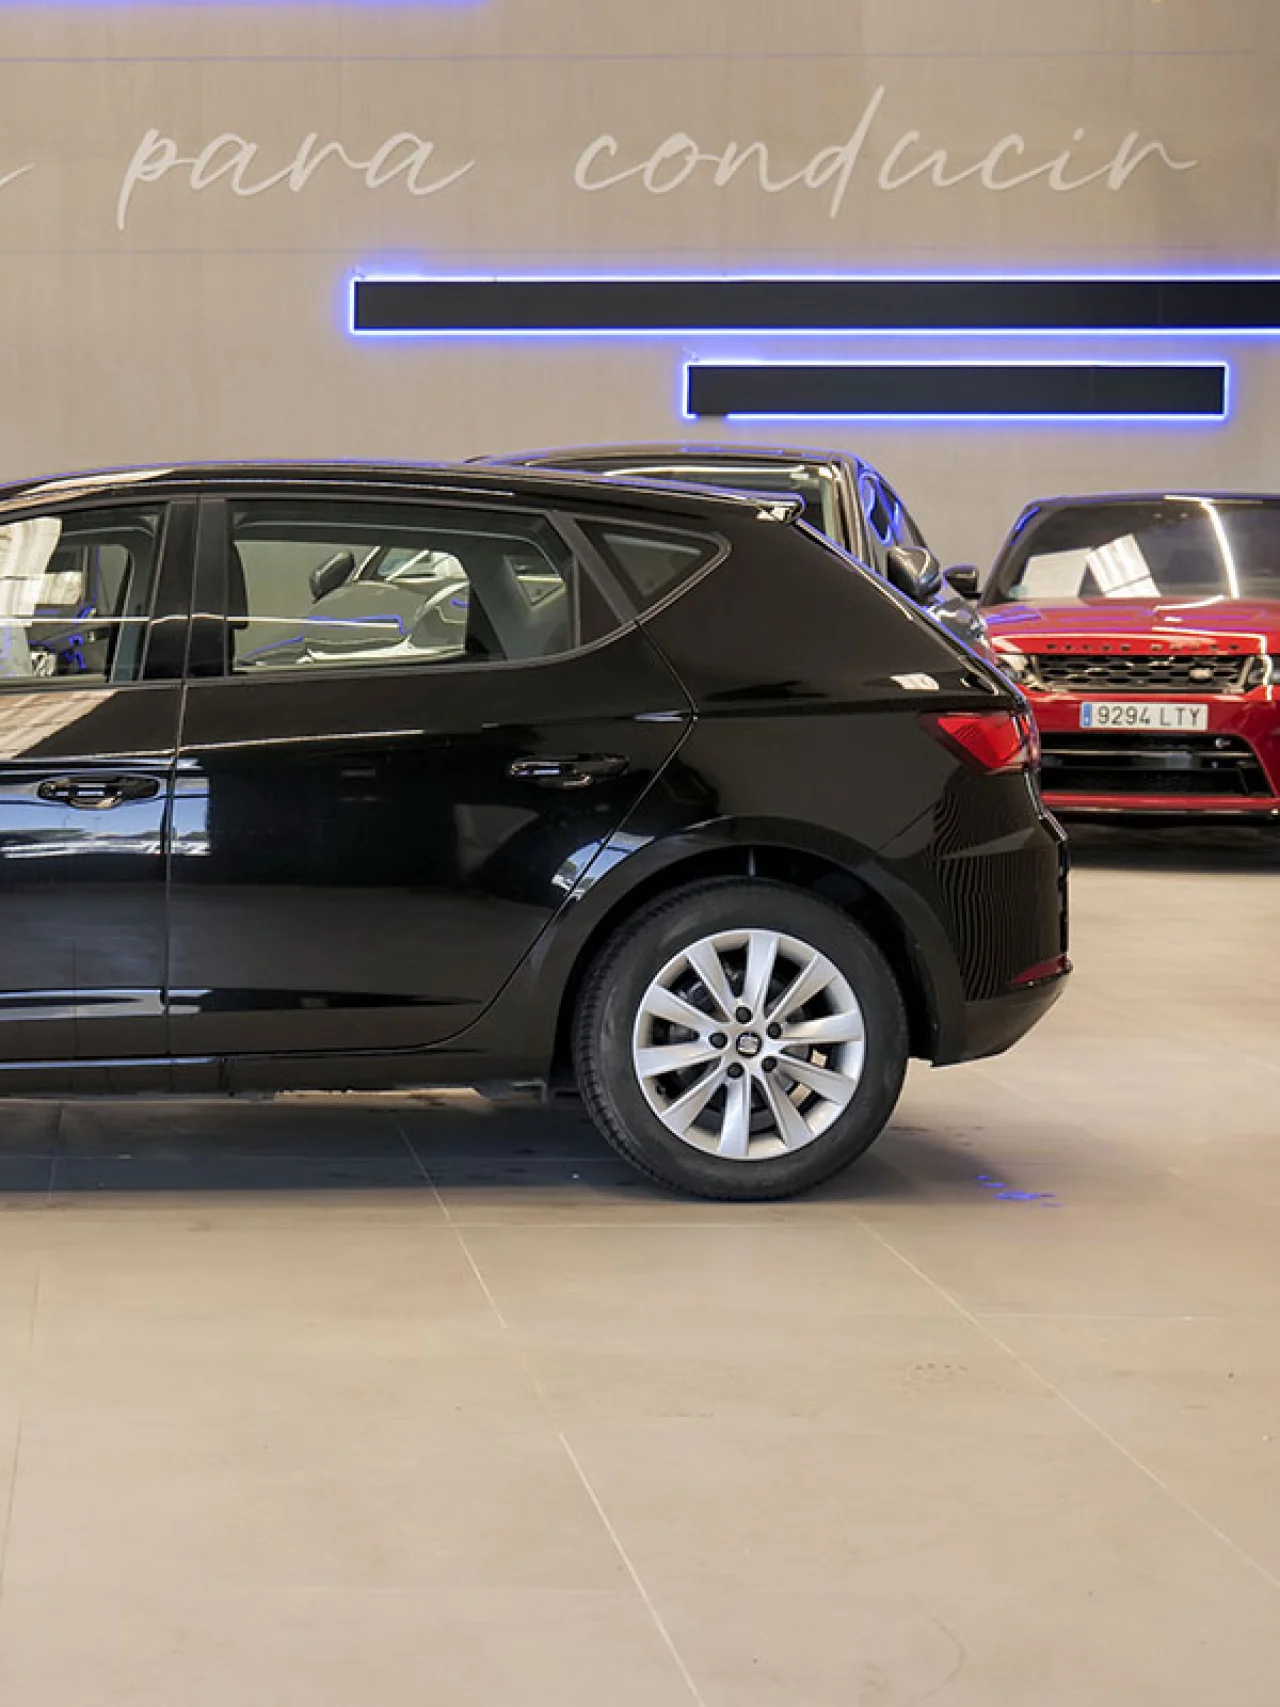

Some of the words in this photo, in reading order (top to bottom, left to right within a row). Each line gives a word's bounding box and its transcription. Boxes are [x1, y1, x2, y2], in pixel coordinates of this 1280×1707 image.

[116, 128, 476, 231] para
[573, 85, 1198, 218] conducir
[1096, 705, 1151, 726] 9294
[1159, 707, 1201, 727] LTY
